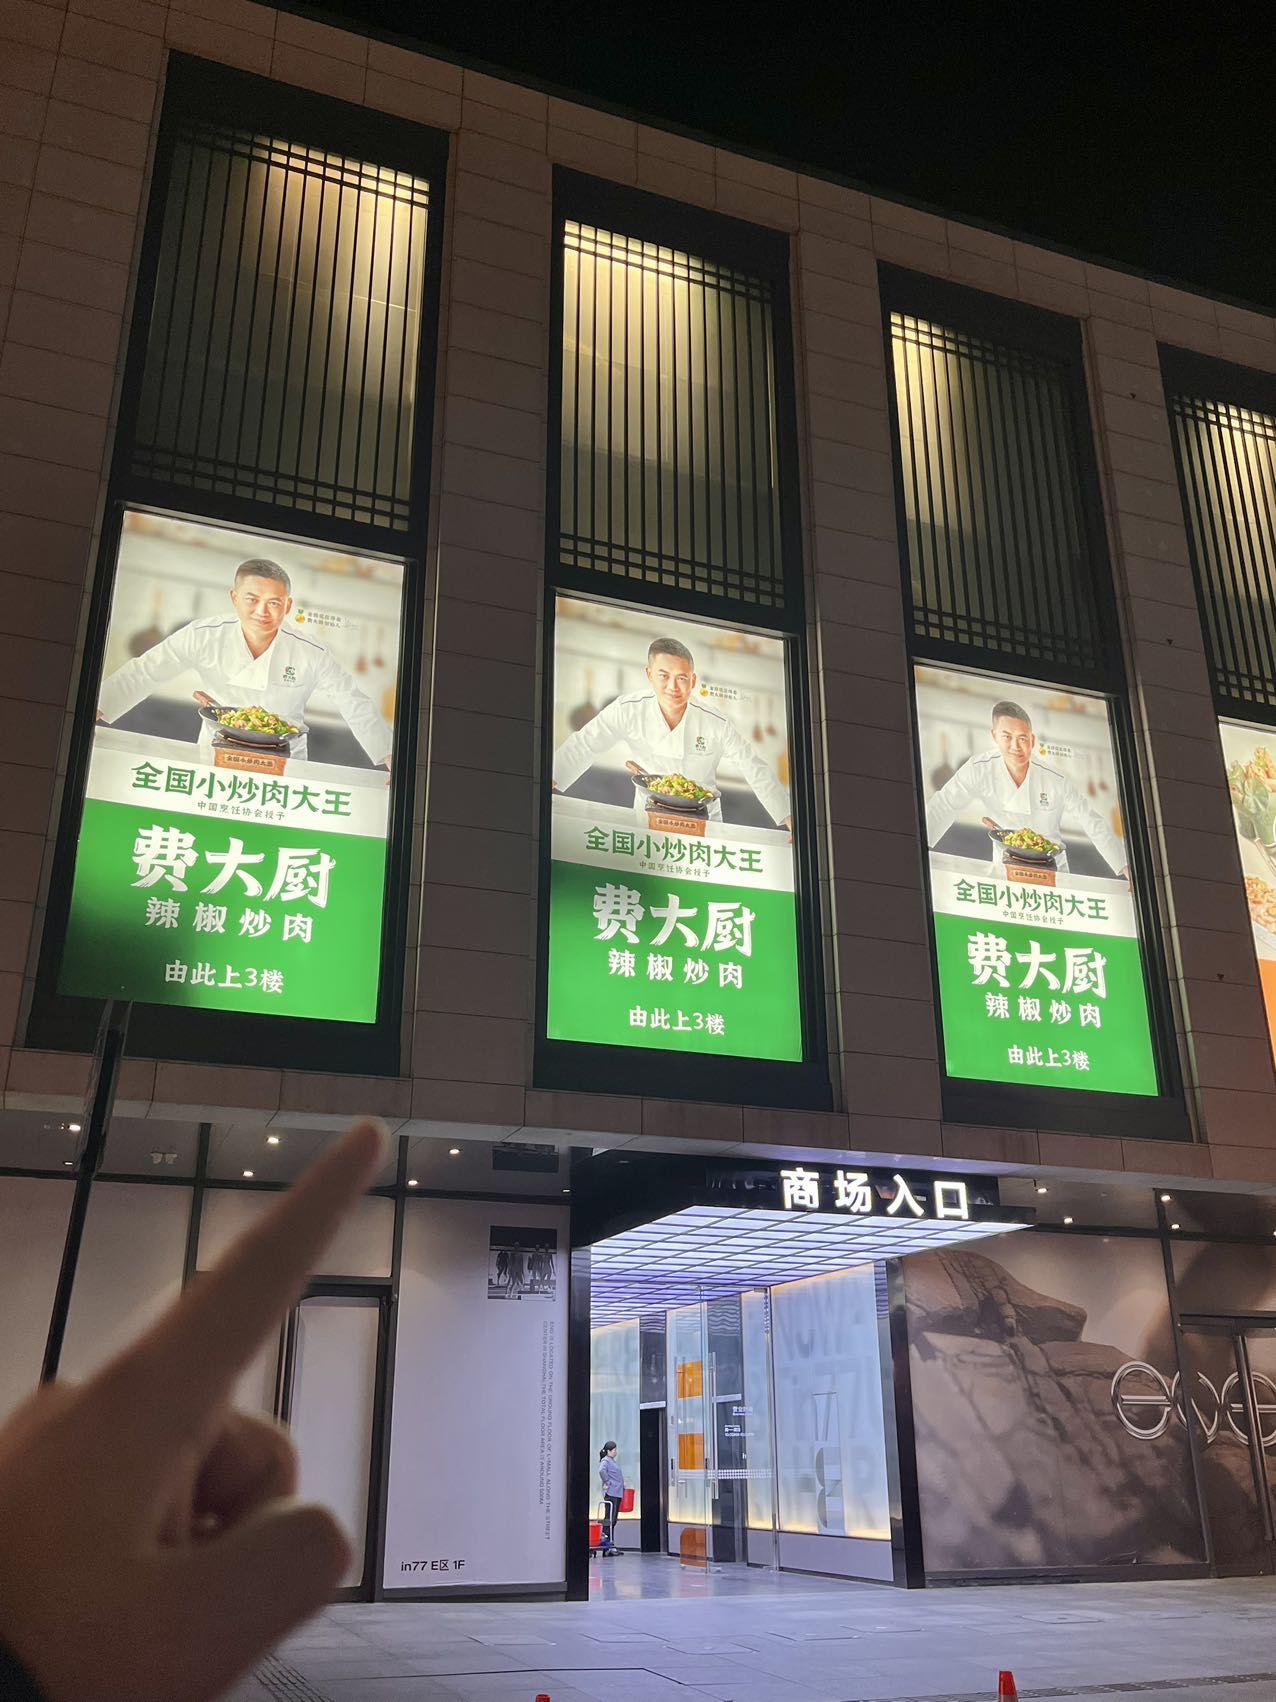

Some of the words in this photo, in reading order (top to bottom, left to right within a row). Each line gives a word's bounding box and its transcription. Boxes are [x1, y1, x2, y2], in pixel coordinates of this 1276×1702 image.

[131, 761, 351, 818] 全国小炒肉大王
[197, 800, 285, 821] 中国烹饪协会授予
[131, 824, 337, 909] 费大厨
[584, 825, 764, 874] 全国小炒肉大王
[639, 860, 711, 878] 中国烹饪协会授予
[144, 896, 313, 943] 辣椒炒肉
[592, 882, 757, 957] 费大厨
[953, 878, 1109, 921] 全国小炒肉大王
[164, 959, 284, 994] 由此上3楼
[608, 947, 743, 989] 辣椒炒肉
[967, 931, 1108, 999] 费大厨
[629, 1005, 725, 1036] 由此上3楼
[985, 991, 1102, 1028] 辣椒炒肉
[1008, 1044, 1090, 1072] 由此上3楼
[779, 1167, 970, 1220] 商场入口
[401, 1561, 428, 1571] in77
[431, 1560, 449, 1571] E区
[453, 1560, 465, 1570] 1F
